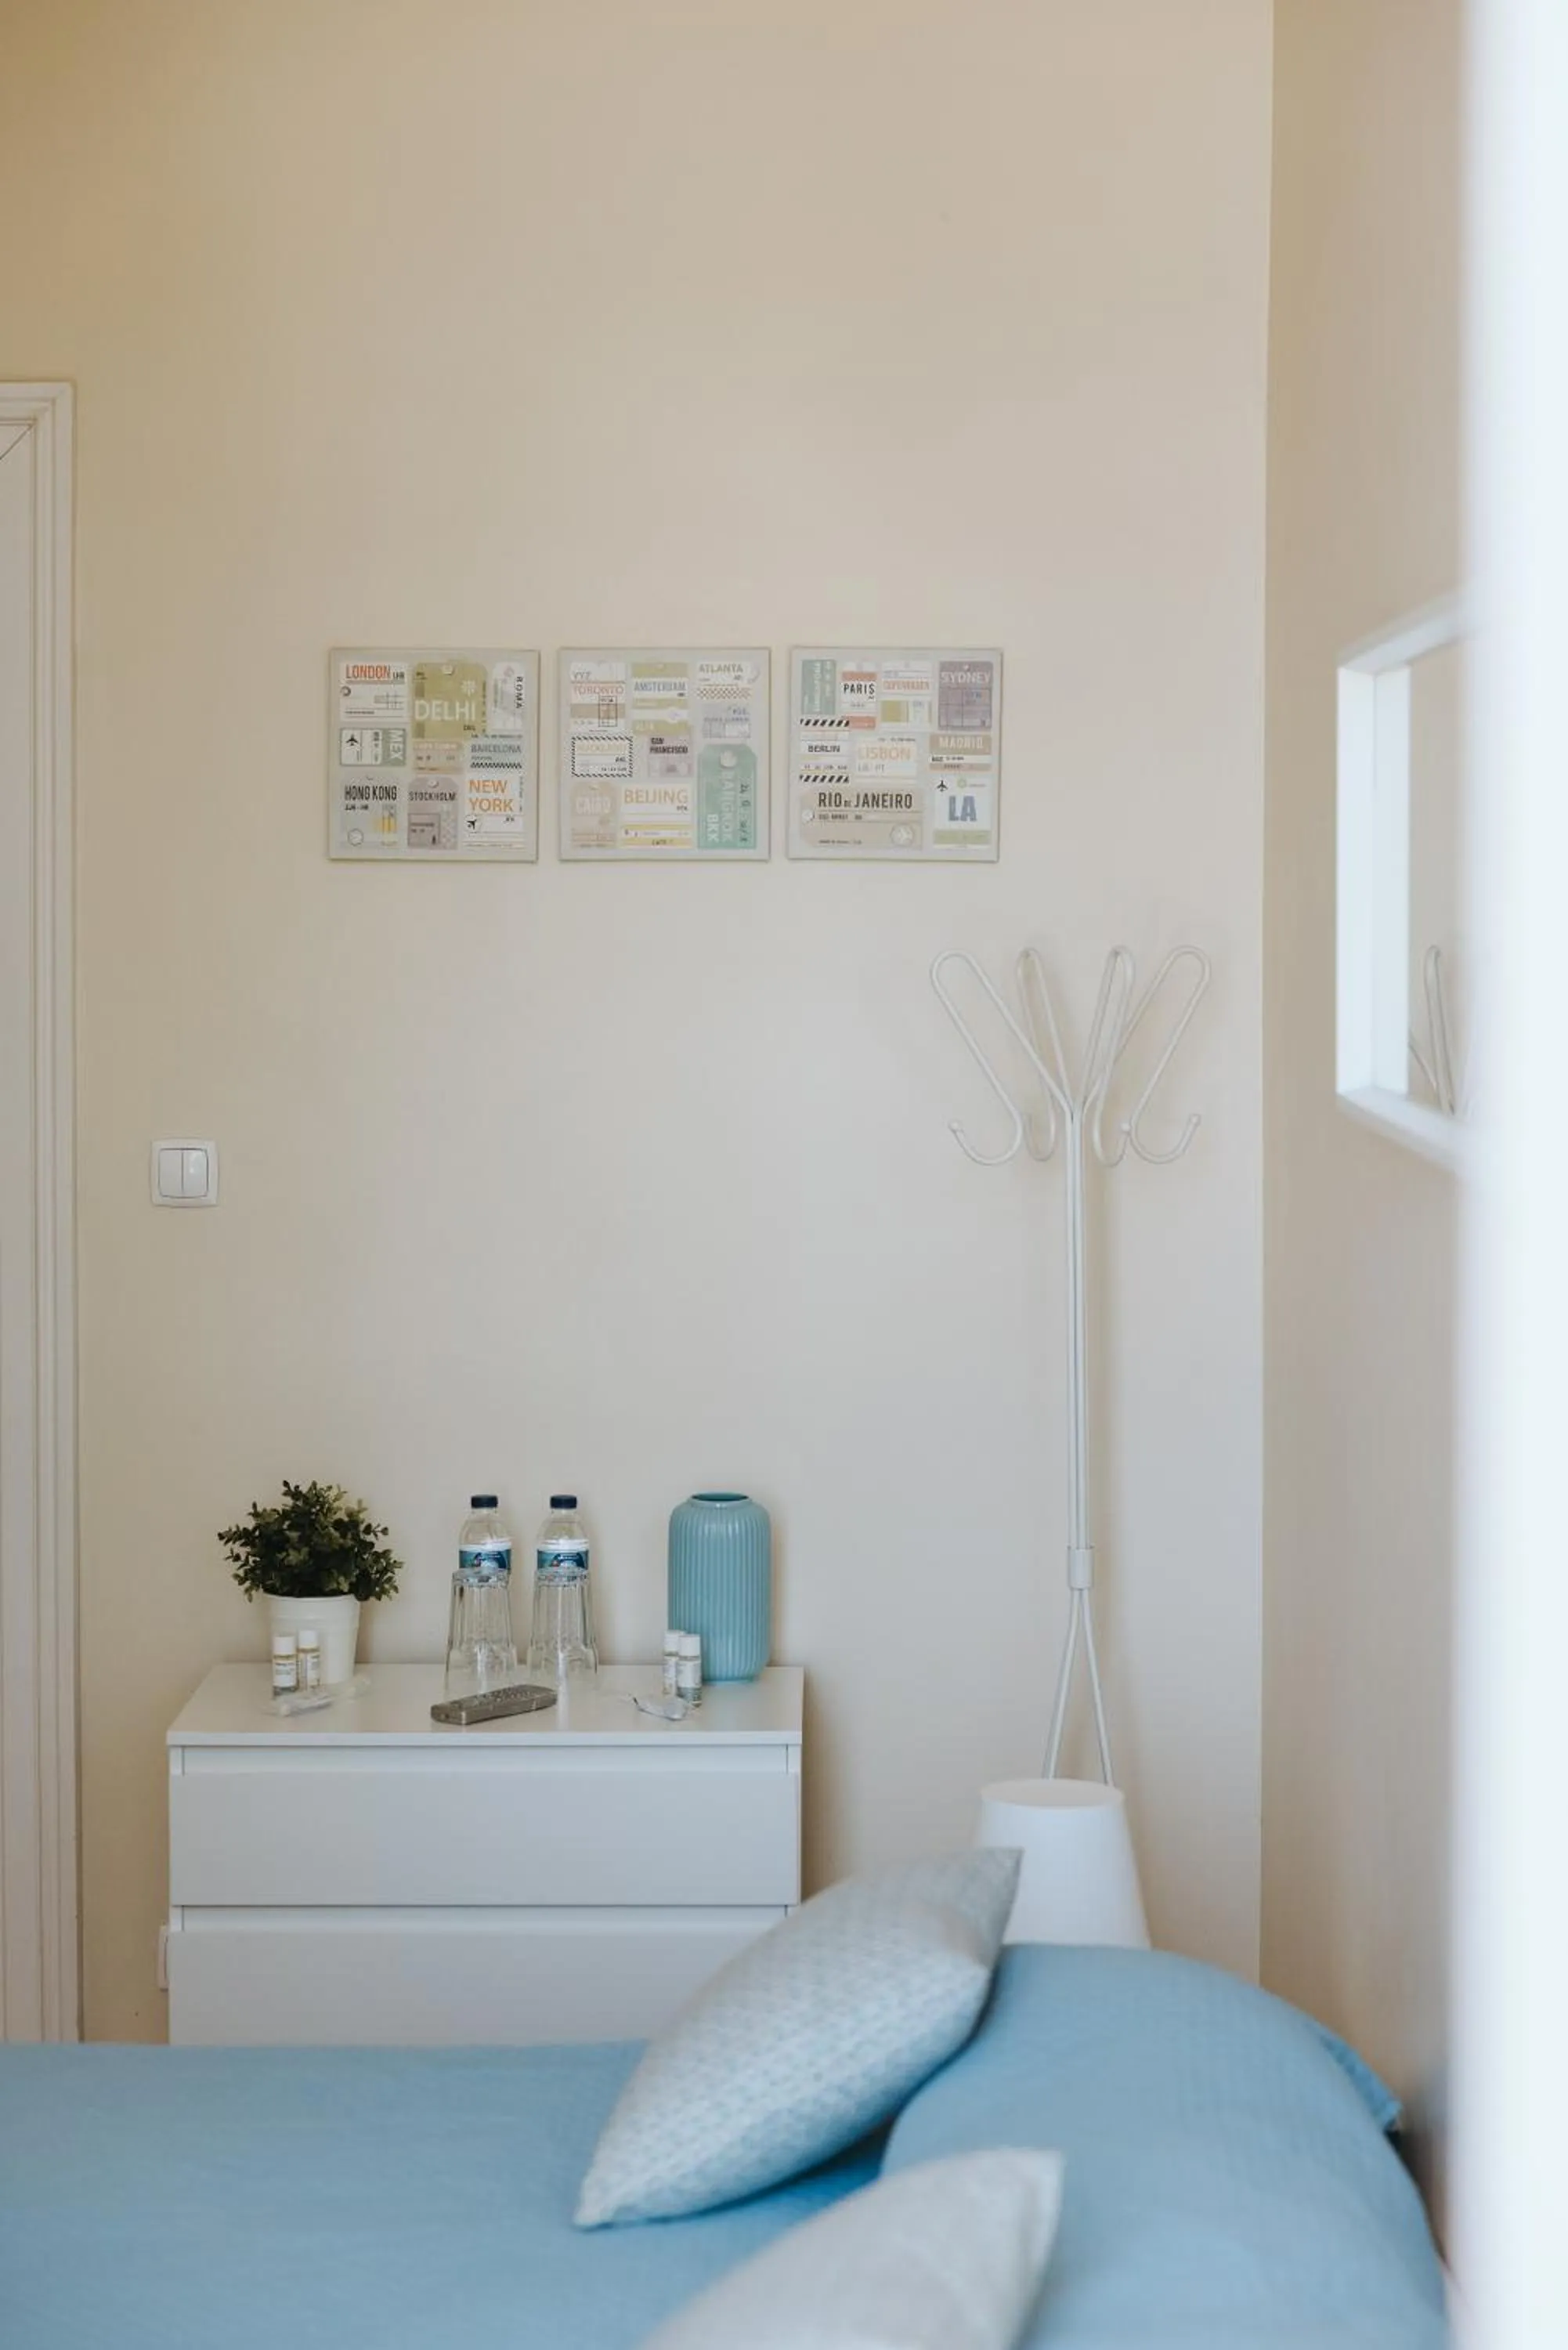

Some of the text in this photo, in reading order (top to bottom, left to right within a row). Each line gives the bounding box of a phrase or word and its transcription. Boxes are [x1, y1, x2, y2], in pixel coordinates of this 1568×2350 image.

[345, 664, 391, 679] LONDON
[699, 663, 743, 673] ATLANTA
[940, 671, 991, 684] SYDNEY
[515, 676, 525, 709] ROMA
[634, 681, 687, 692] AMSTERDAM
[844, 682, 876, 696] PARIS
[414, 700, 476, 721] DELHI
[390, 729, 404, 761] MEX
[471, 743, 522, 754] BARCELONA
[649, 746, 688, 754] FRANCISCO
[807, 745, 840, 754] BERLIN
[939, 736, 984, 750] MADRID
[858, 747, 911, 761] LISBON
[345, 785, 398, 801] HONG KONG
[469, 779, 508, 794] NEW
[408, 792, 457, 801] STOCKHOLM
[624, 788, 688, 804] BEIJING
[818, 792, 842, 808] RIO
[854, 793, 913, 810] JANEIRO
[469, 797, 514, 812] YORK
[721, 770, 735, 842] BANGKOK
[948, 795, 977, 822] LA
[706, 813, 719, 844] BKK
